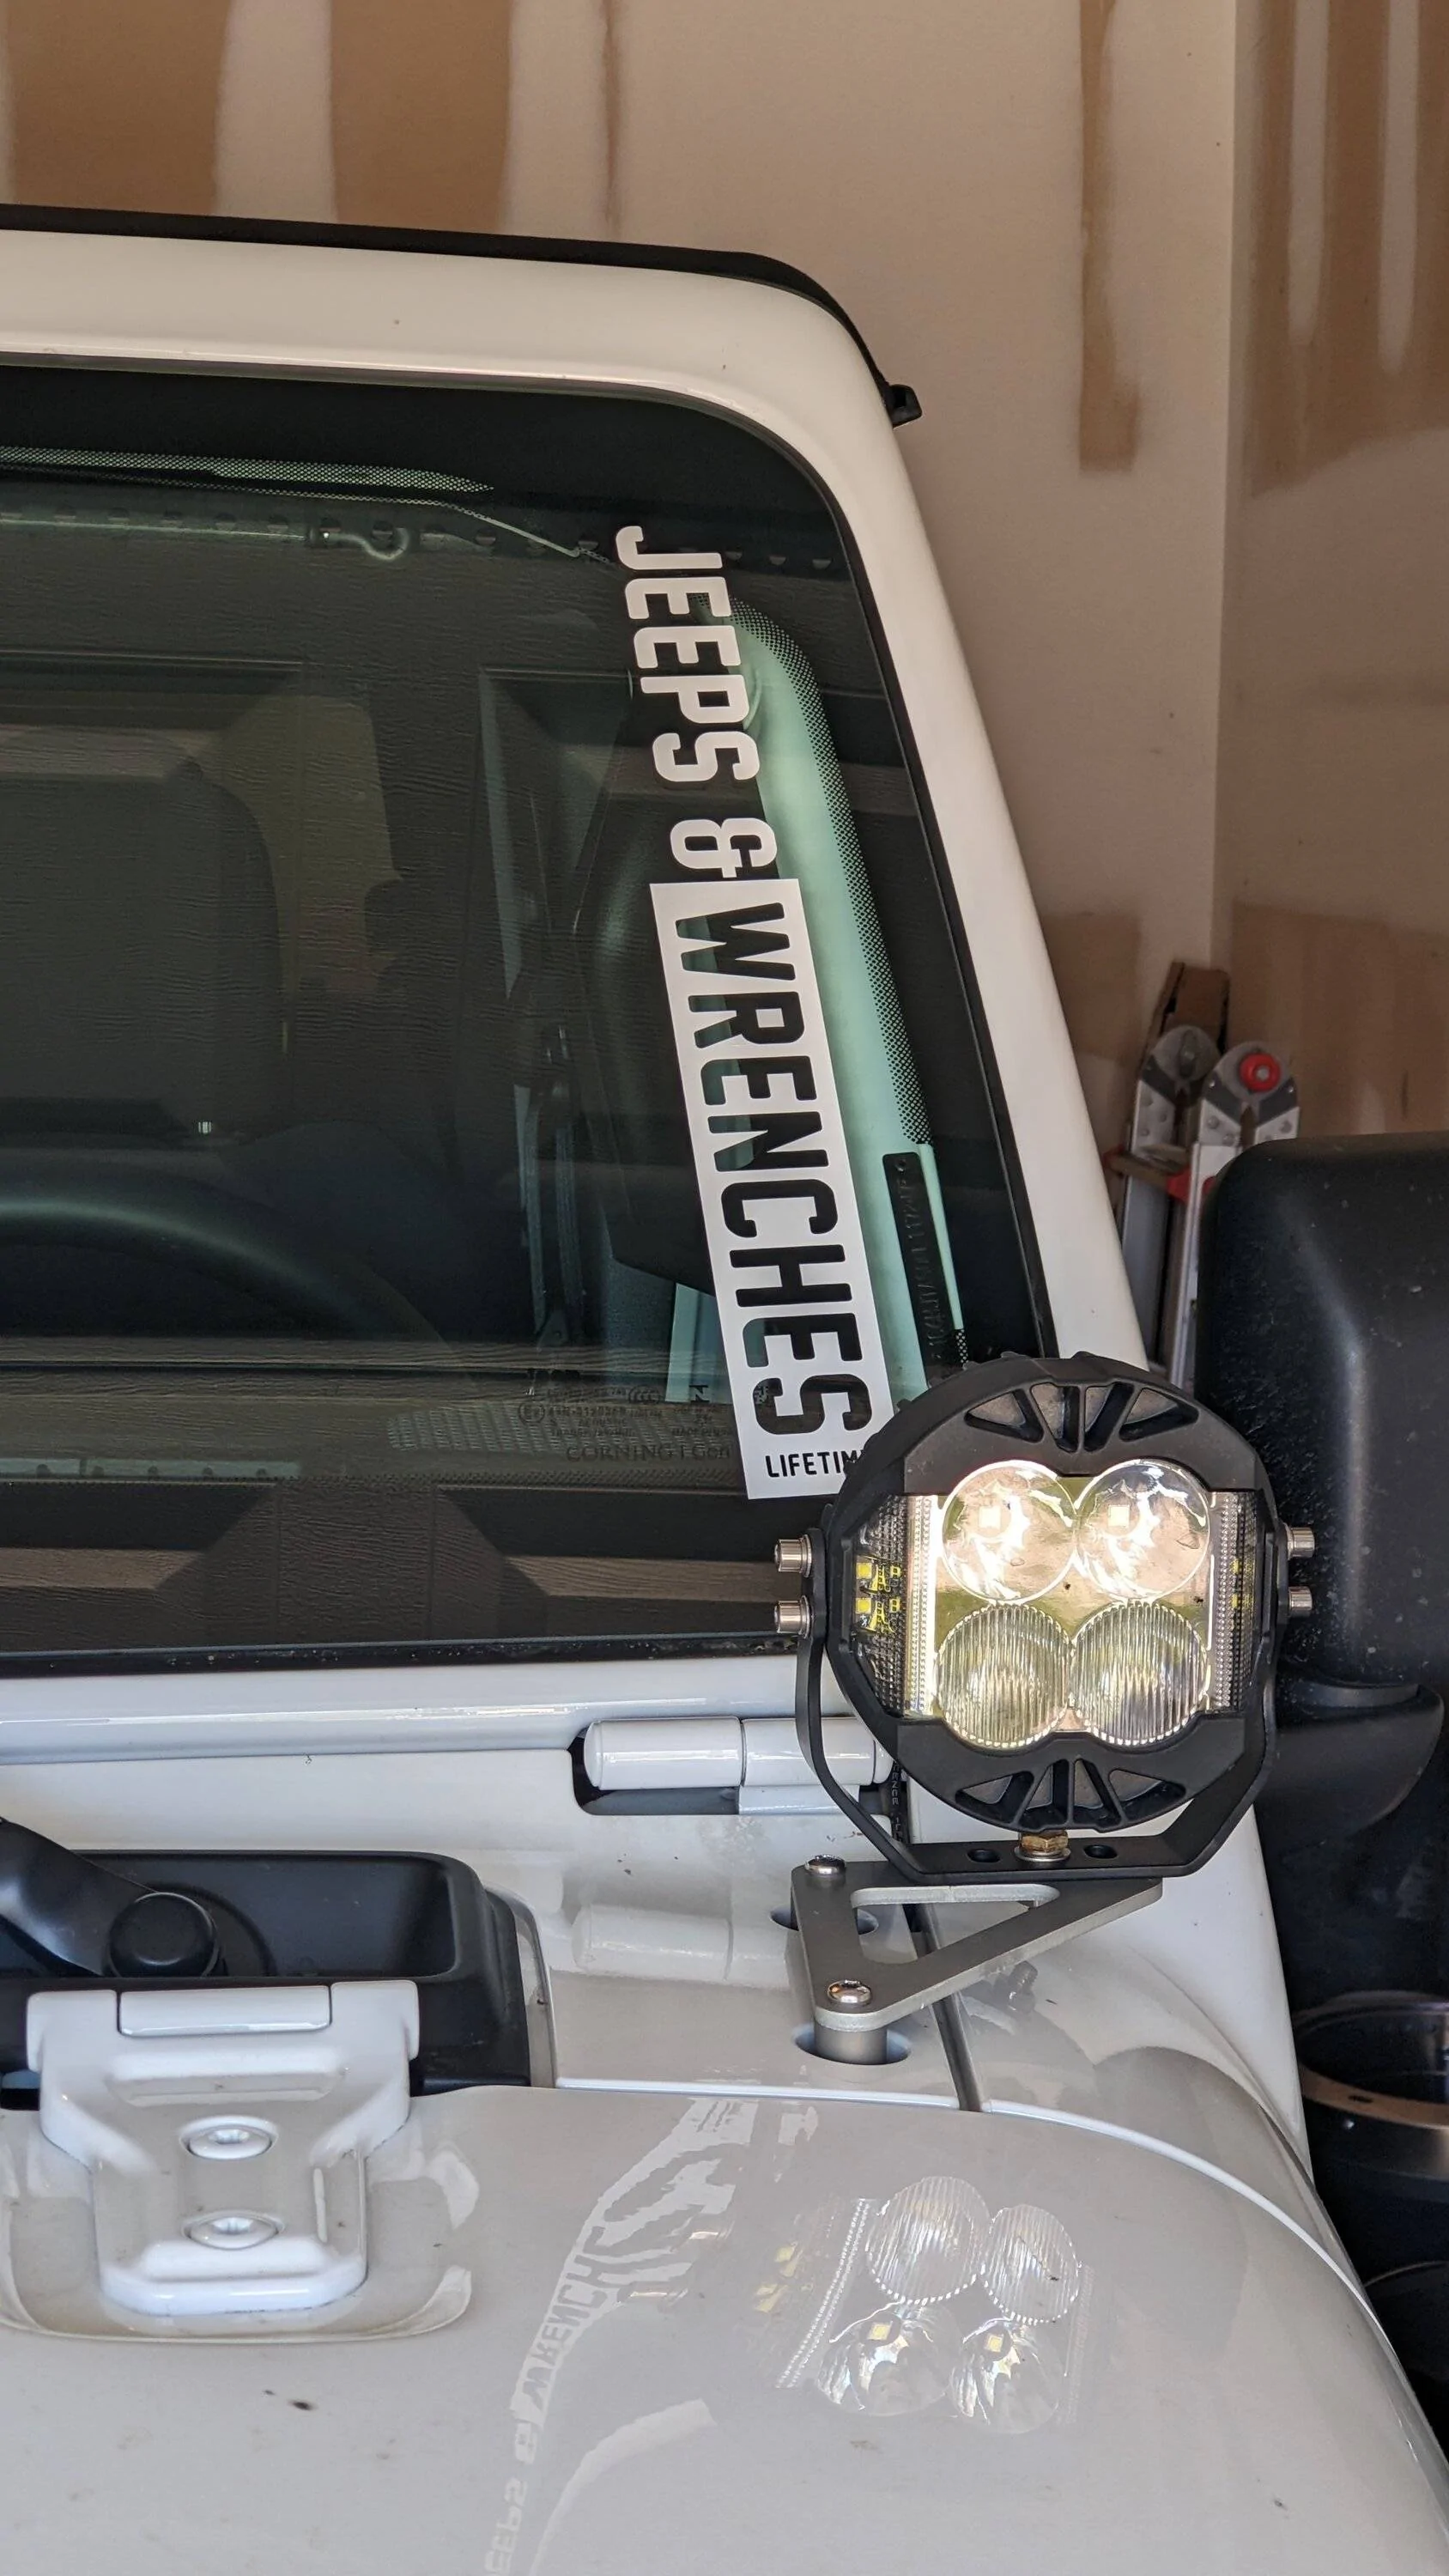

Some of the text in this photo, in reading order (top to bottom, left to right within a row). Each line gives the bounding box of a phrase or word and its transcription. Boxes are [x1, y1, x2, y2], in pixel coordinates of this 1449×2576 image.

[615, 526, 760, 782] JEEPS
[670, 817, 778, 878] &
[676, 902, 872, 1435] WRENCHES
[566, 1444, 675, 1461] CORNING
[765, 1449, 864, 1478] LIFETIM
